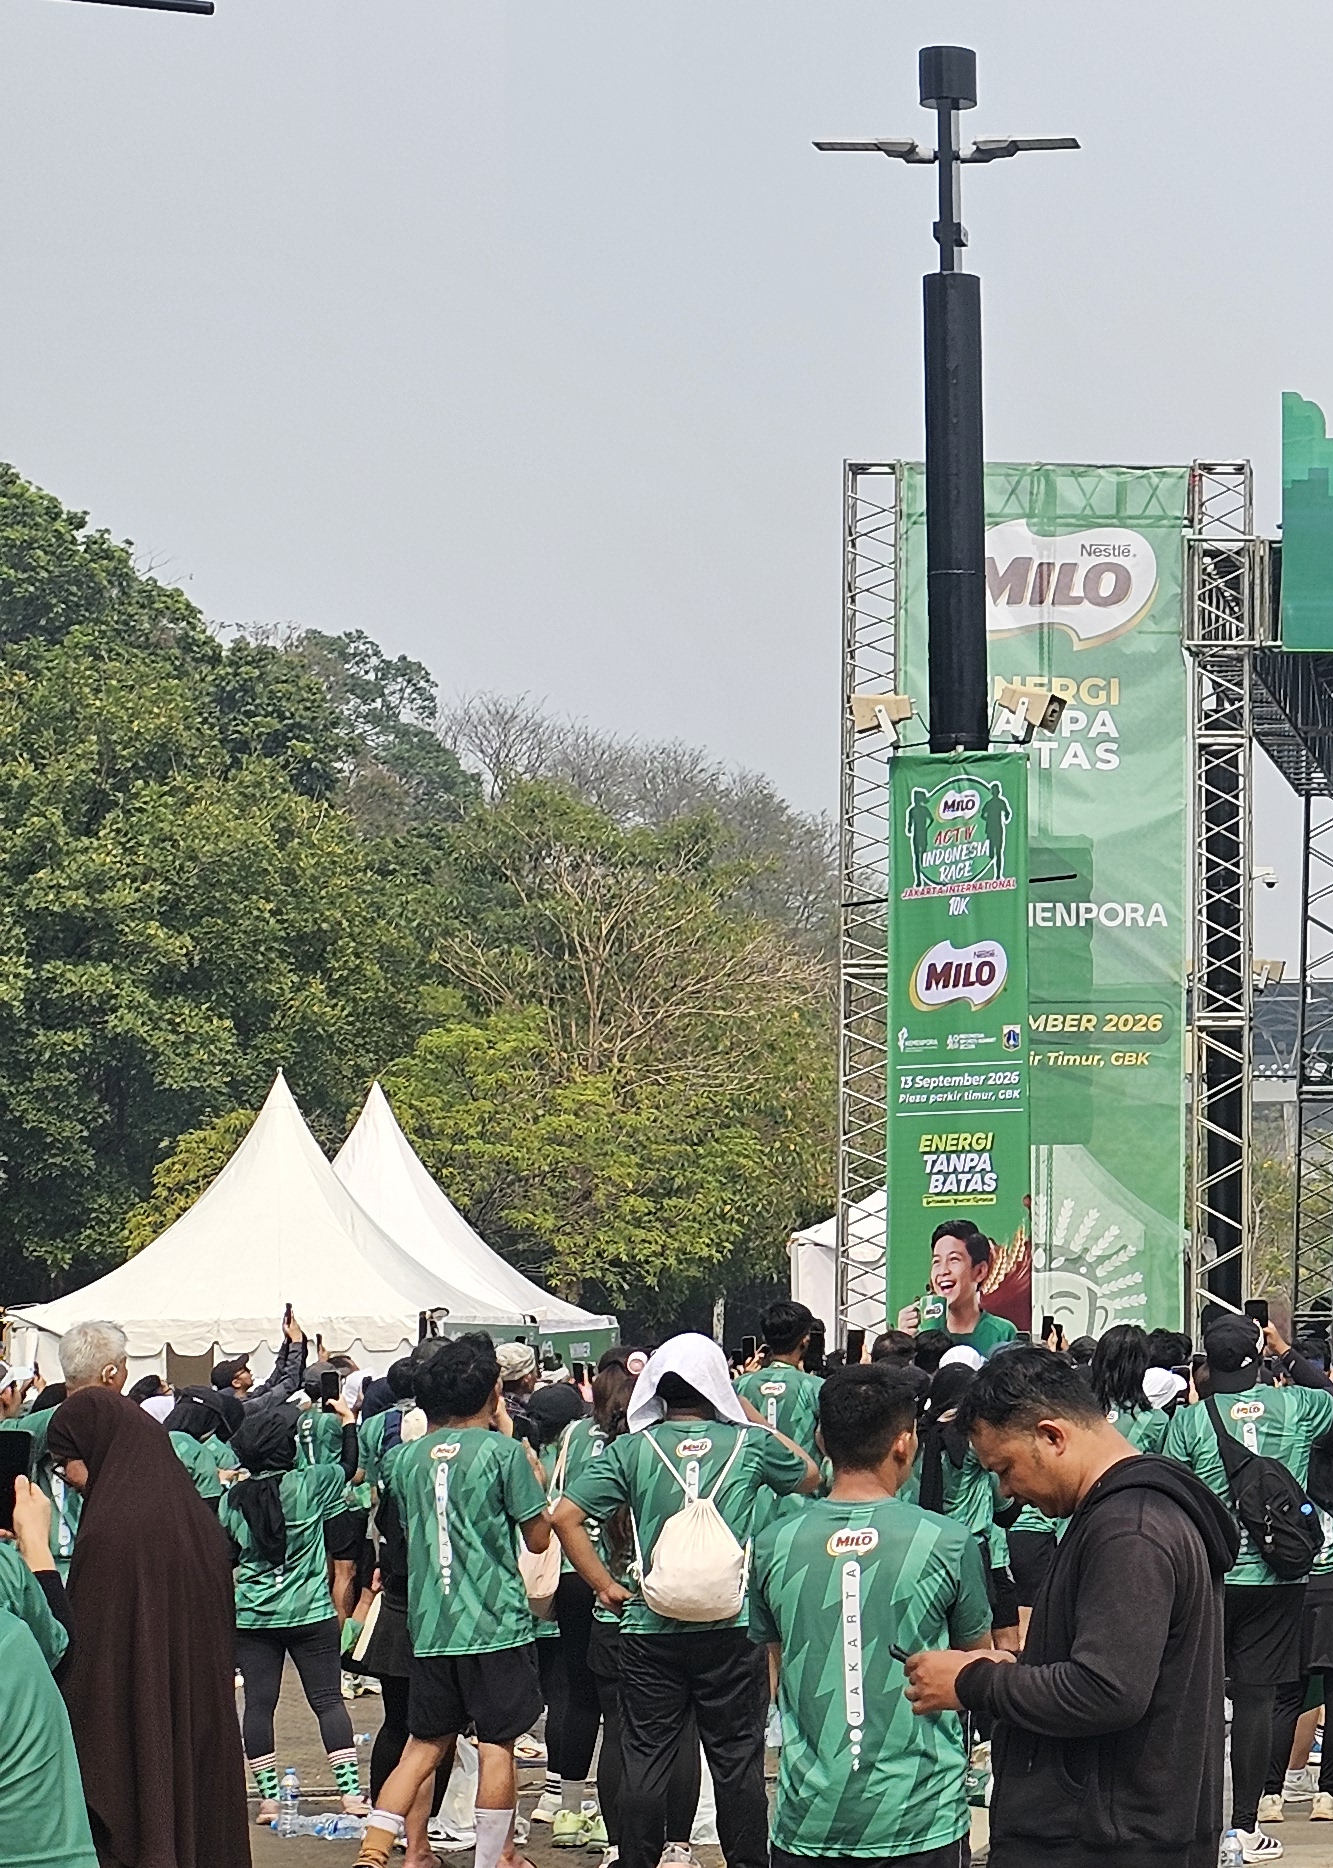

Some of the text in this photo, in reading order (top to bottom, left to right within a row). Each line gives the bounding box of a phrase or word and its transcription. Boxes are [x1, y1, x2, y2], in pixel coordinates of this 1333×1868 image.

[922, 839, 990, 867] INDONESIA
[939, 860, 973, 883] RACE
[903, 879, 1016, 898] JAKARTA INTERNATIONAL
[949, 896, 970, 915] 10K
[925, 962, 996, 991] MILO
[1103, 1014, 1163, 1032] 2026
[1047, 1051, 1105, 1067] Timur,
[1110, 1052, 1152, 1066] GBK
[900, 1071, 1020, 1090] 13 September 2026
[899, 1094, 927, 1104] Plaza
[929, 1091, 962, 1105] parkir
[998, 1089, 1021, 1099] GBK
[919, 1132, 993, 1152] ENERGI
[923, 1153, 992, 1174] TANPA
[928, 1172, 998, 1194] BATAS
[836, 1532, 873, 1548] MILO
[846, 1568, 861, 1718] JAKARTA
